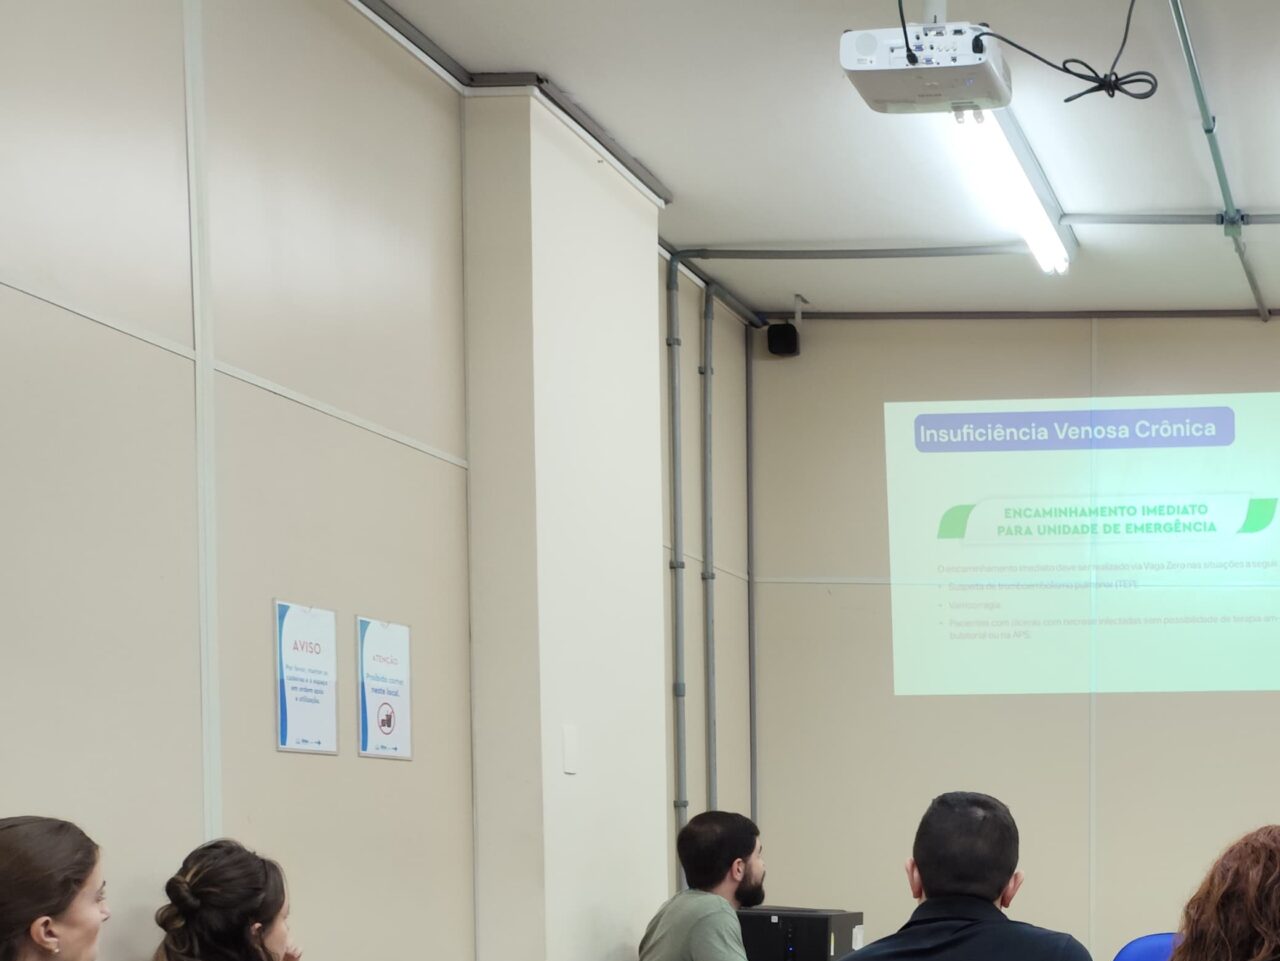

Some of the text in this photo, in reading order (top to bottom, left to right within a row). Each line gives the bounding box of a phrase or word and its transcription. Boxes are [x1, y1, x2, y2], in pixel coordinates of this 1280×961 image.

[920, 419, 1217, 443] Insuficiência Venosa Crônica
[1004, 504, 1209, 519] ENCAMINHAMENTO IMEDIATO
[997, 518, 1217, 537] PARA UNIDADE DE EMERGÊNCIA
[292, 639, 322, 655] AVISO
